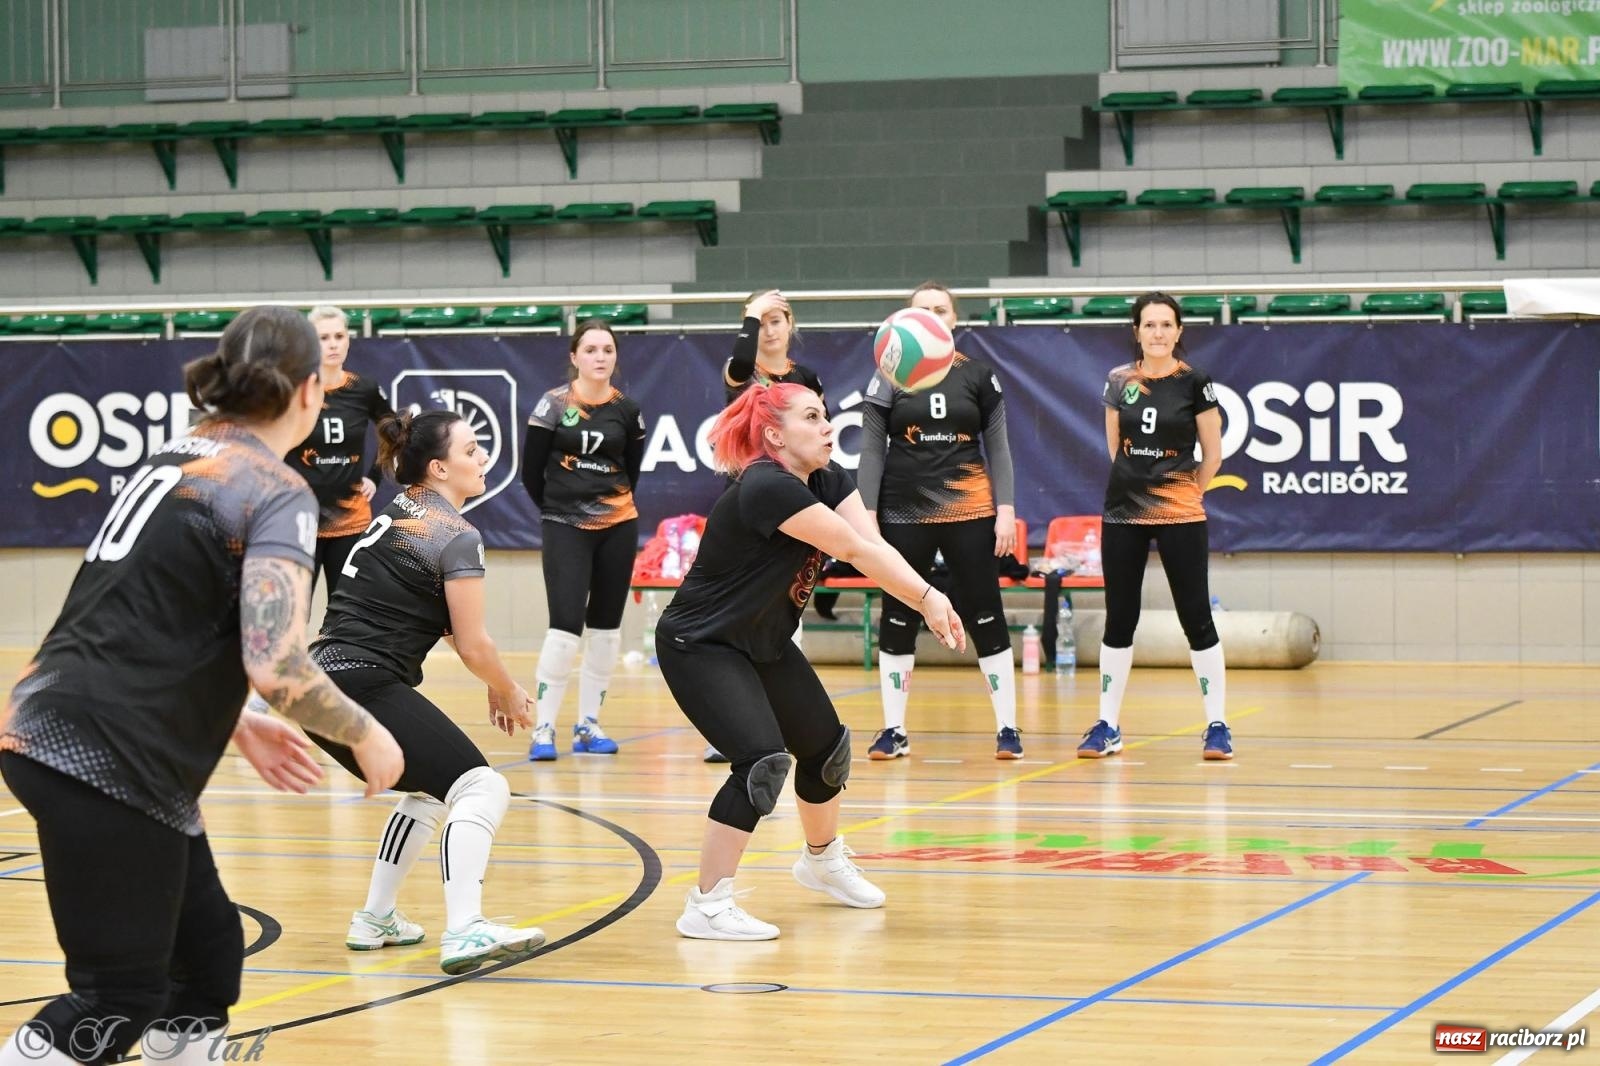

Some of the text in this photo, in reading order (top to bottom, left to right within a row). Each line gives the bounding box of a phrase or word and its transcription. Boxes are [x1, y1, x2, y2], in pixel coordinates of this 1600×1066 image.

[1457, 0, 1504, 17] sklep
[930, 393, 947, 419] 8
[323, 417, 345, 444] 13
[1141, 407, 1158, 434] 9
[581, 430, 605, 454] 17
[920, 432, 957, 443] Fundacja
[1262, 465, 1409, 494] RACIBÓRZ
[85, 465, 183, 562] 10
[341, 514, 393, 579] 2
